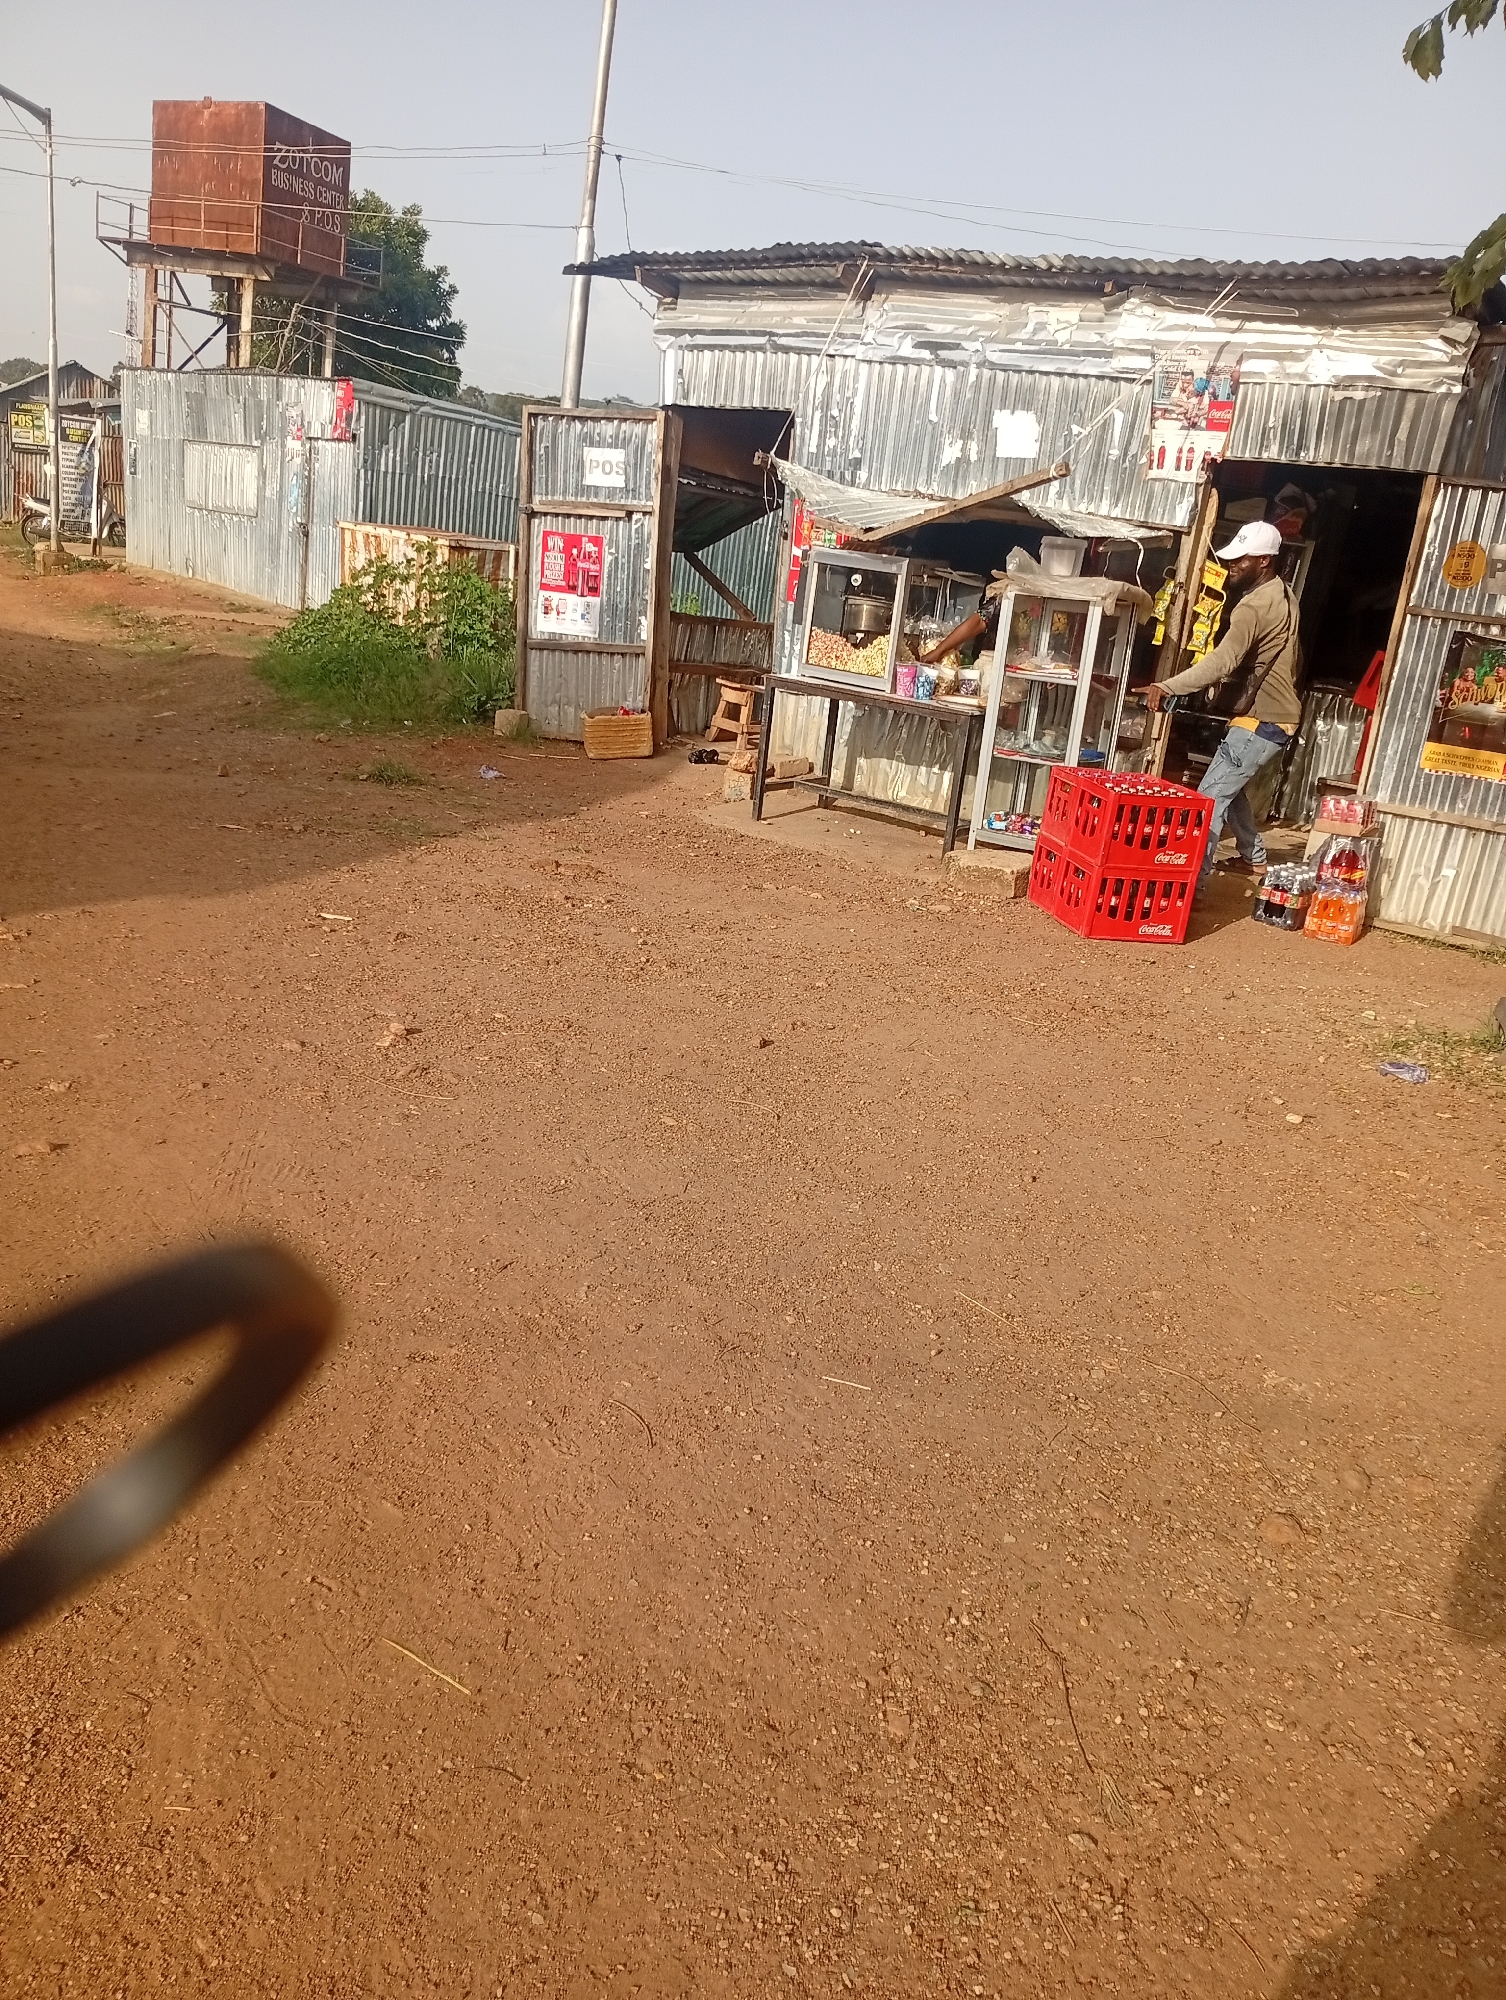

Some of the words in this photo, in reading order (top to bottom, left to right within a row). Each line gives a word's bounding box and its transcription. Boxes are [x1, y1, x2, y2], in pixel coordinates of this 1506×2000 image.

[273, 141, 343, 187] ZOTCOM
[271, 167, 315, 200] BUSINESS
[316, 185, 345, 210] CENTER
[301, 202, 310, 223] &
[11, 413, 33, 427] POS
[588, 459, 625, 476] POS
[1154, 852, 1189, 865] Coca-Cola
[1138, 925, 1173, 936] Coca-Cola
